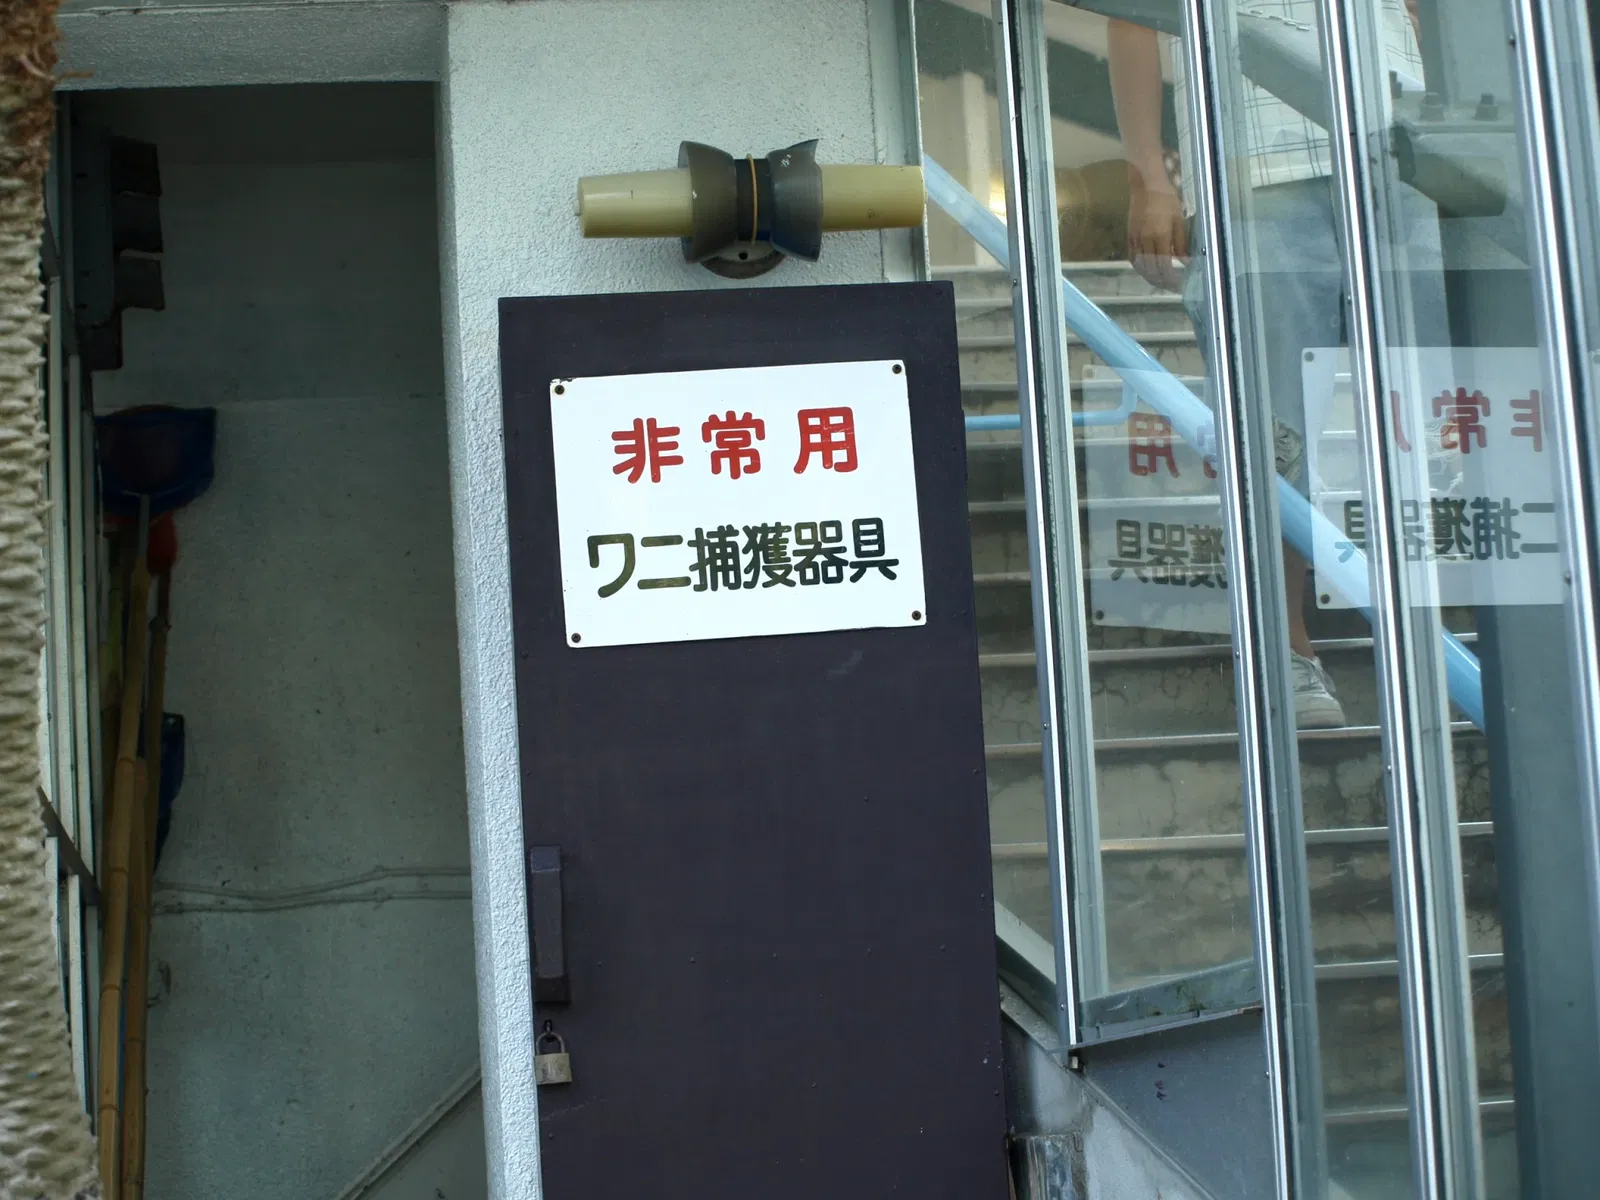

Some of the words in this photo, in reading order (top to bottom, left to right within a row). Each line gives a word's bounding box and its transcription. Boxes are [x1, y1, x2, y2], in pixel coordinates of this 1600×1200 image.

[611, 406, 858, 483] 非常用
[586, 517, 900, 598] ワニ捕獲器具
